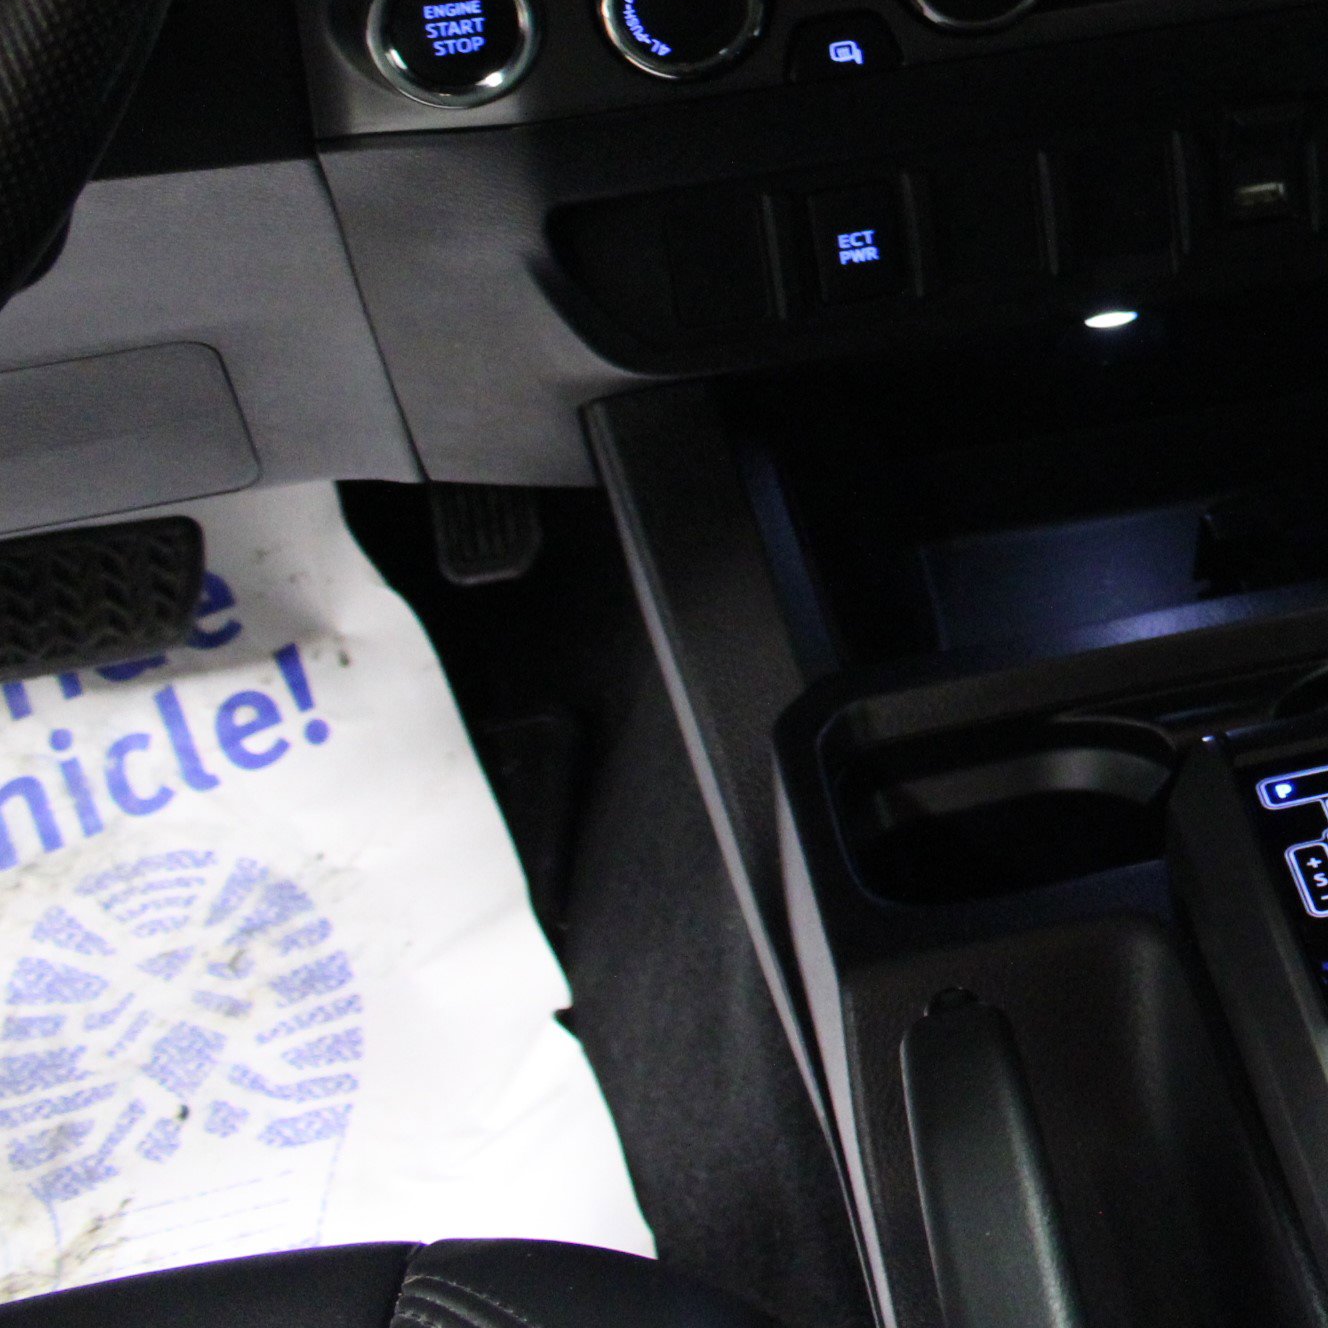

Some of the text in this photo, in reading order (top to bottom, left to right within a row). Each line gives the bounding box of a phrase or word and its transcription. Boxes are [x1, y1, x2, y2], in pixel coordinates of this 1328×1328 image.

[422, 0, 482, 21] ENGINE
[424, 15, 486, 40] START
[432, 34, 486, 57] STOP
[837, 229, 875, 249] ECT
[837, 245, 880, 266] PWR
[1274, 783, 1293, 799] P
